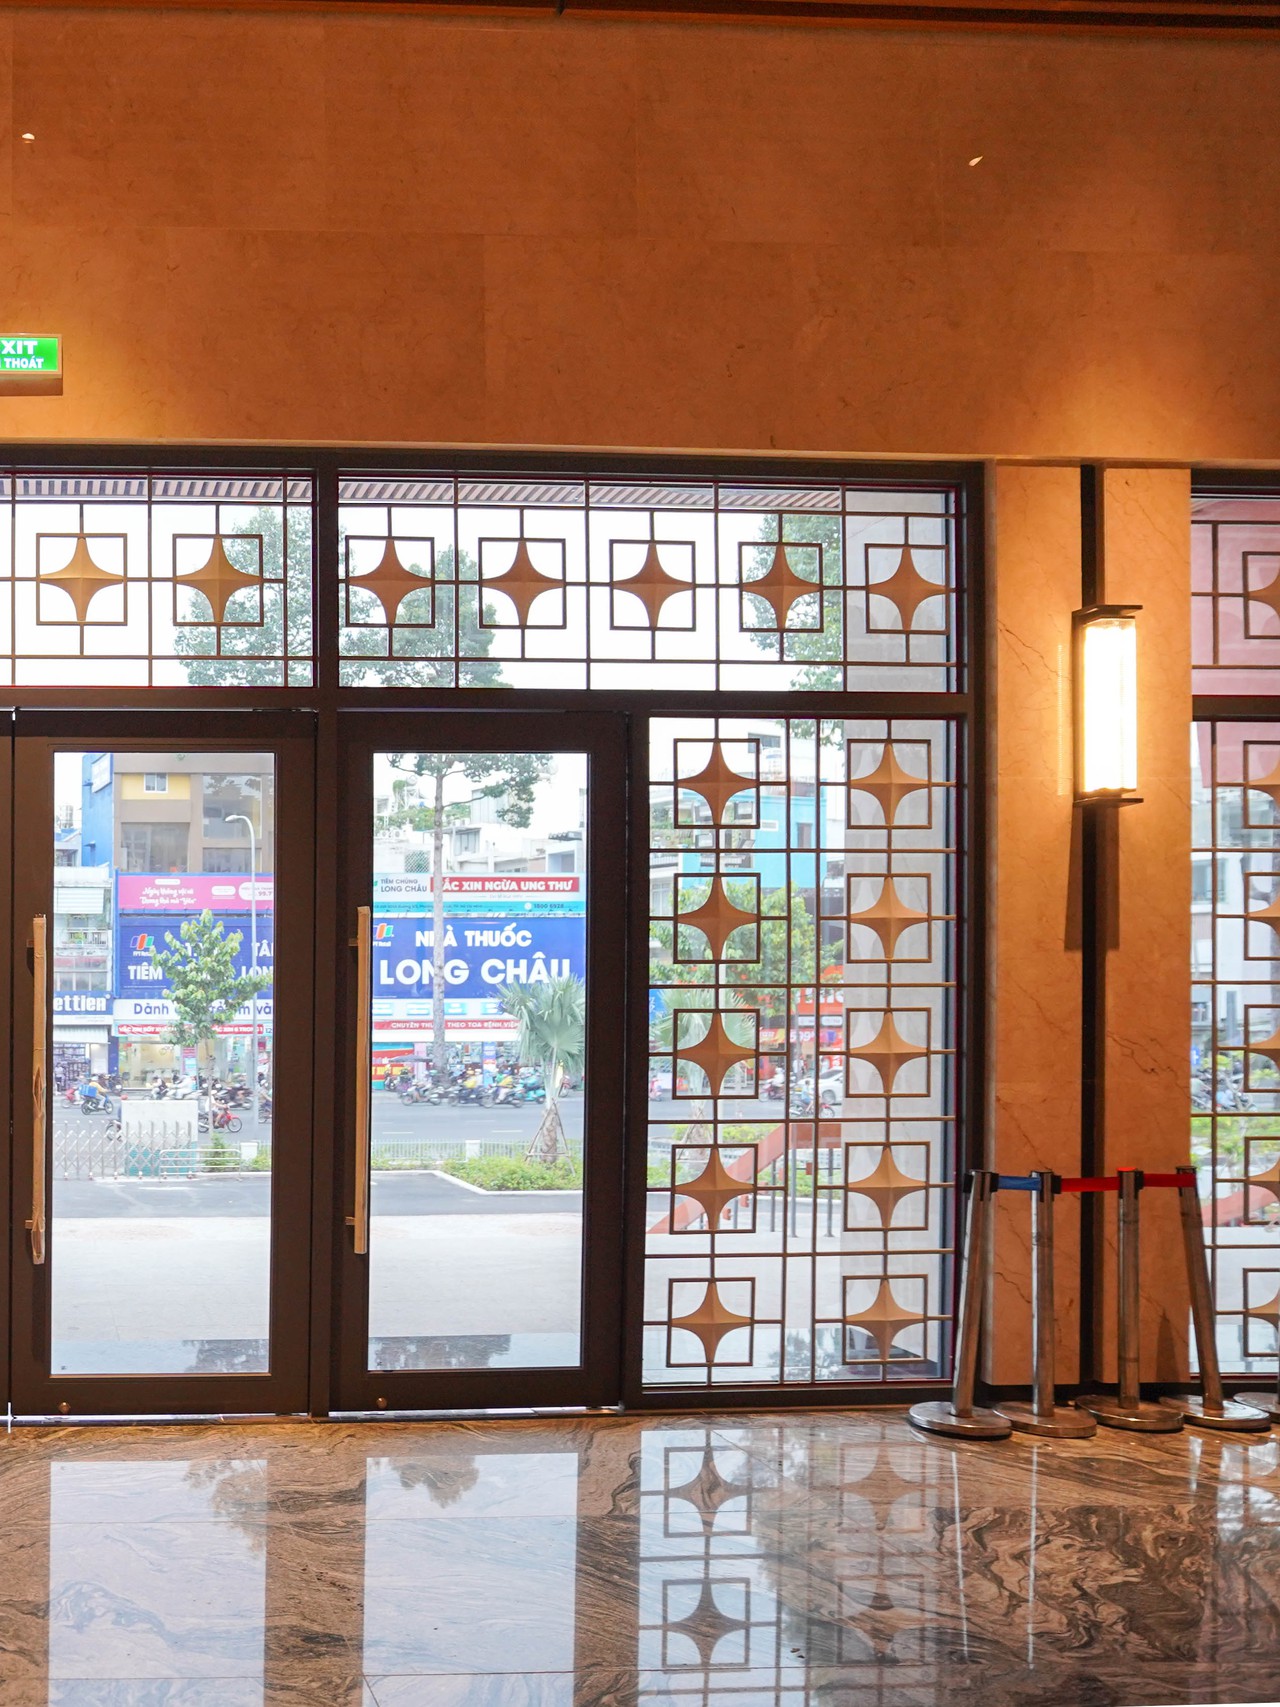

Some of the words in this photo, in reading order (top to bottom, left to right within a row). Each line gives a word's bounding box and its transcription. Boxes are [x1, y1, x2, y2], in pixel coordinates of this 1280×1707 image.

[4, 356, 44, 368] THOÁT
[380, 885, 403, 893] LONG
[405, 883, 428, 893] CHÂU
[441, 877, 461, 891] ẮC
[462, 881, 483, 891] XIN
[485, 878, 519, 891] NGỪA
[521, 881, 545, 891] UNG
[548, 879, 574, 891] THƯ
[464, 922, 532, 947] THUỐC
[251, 939, 274, 957] TÂ
[128, 962, 163, 980] TIÊM
[241, 966, 274, 978] LON
[380, 958, 469, 985] LONG
[481, 951, 570, 985] CHÂU
[53, 995, 107, 1012] ettien
[134, 1003, 169, 1015] Dành
